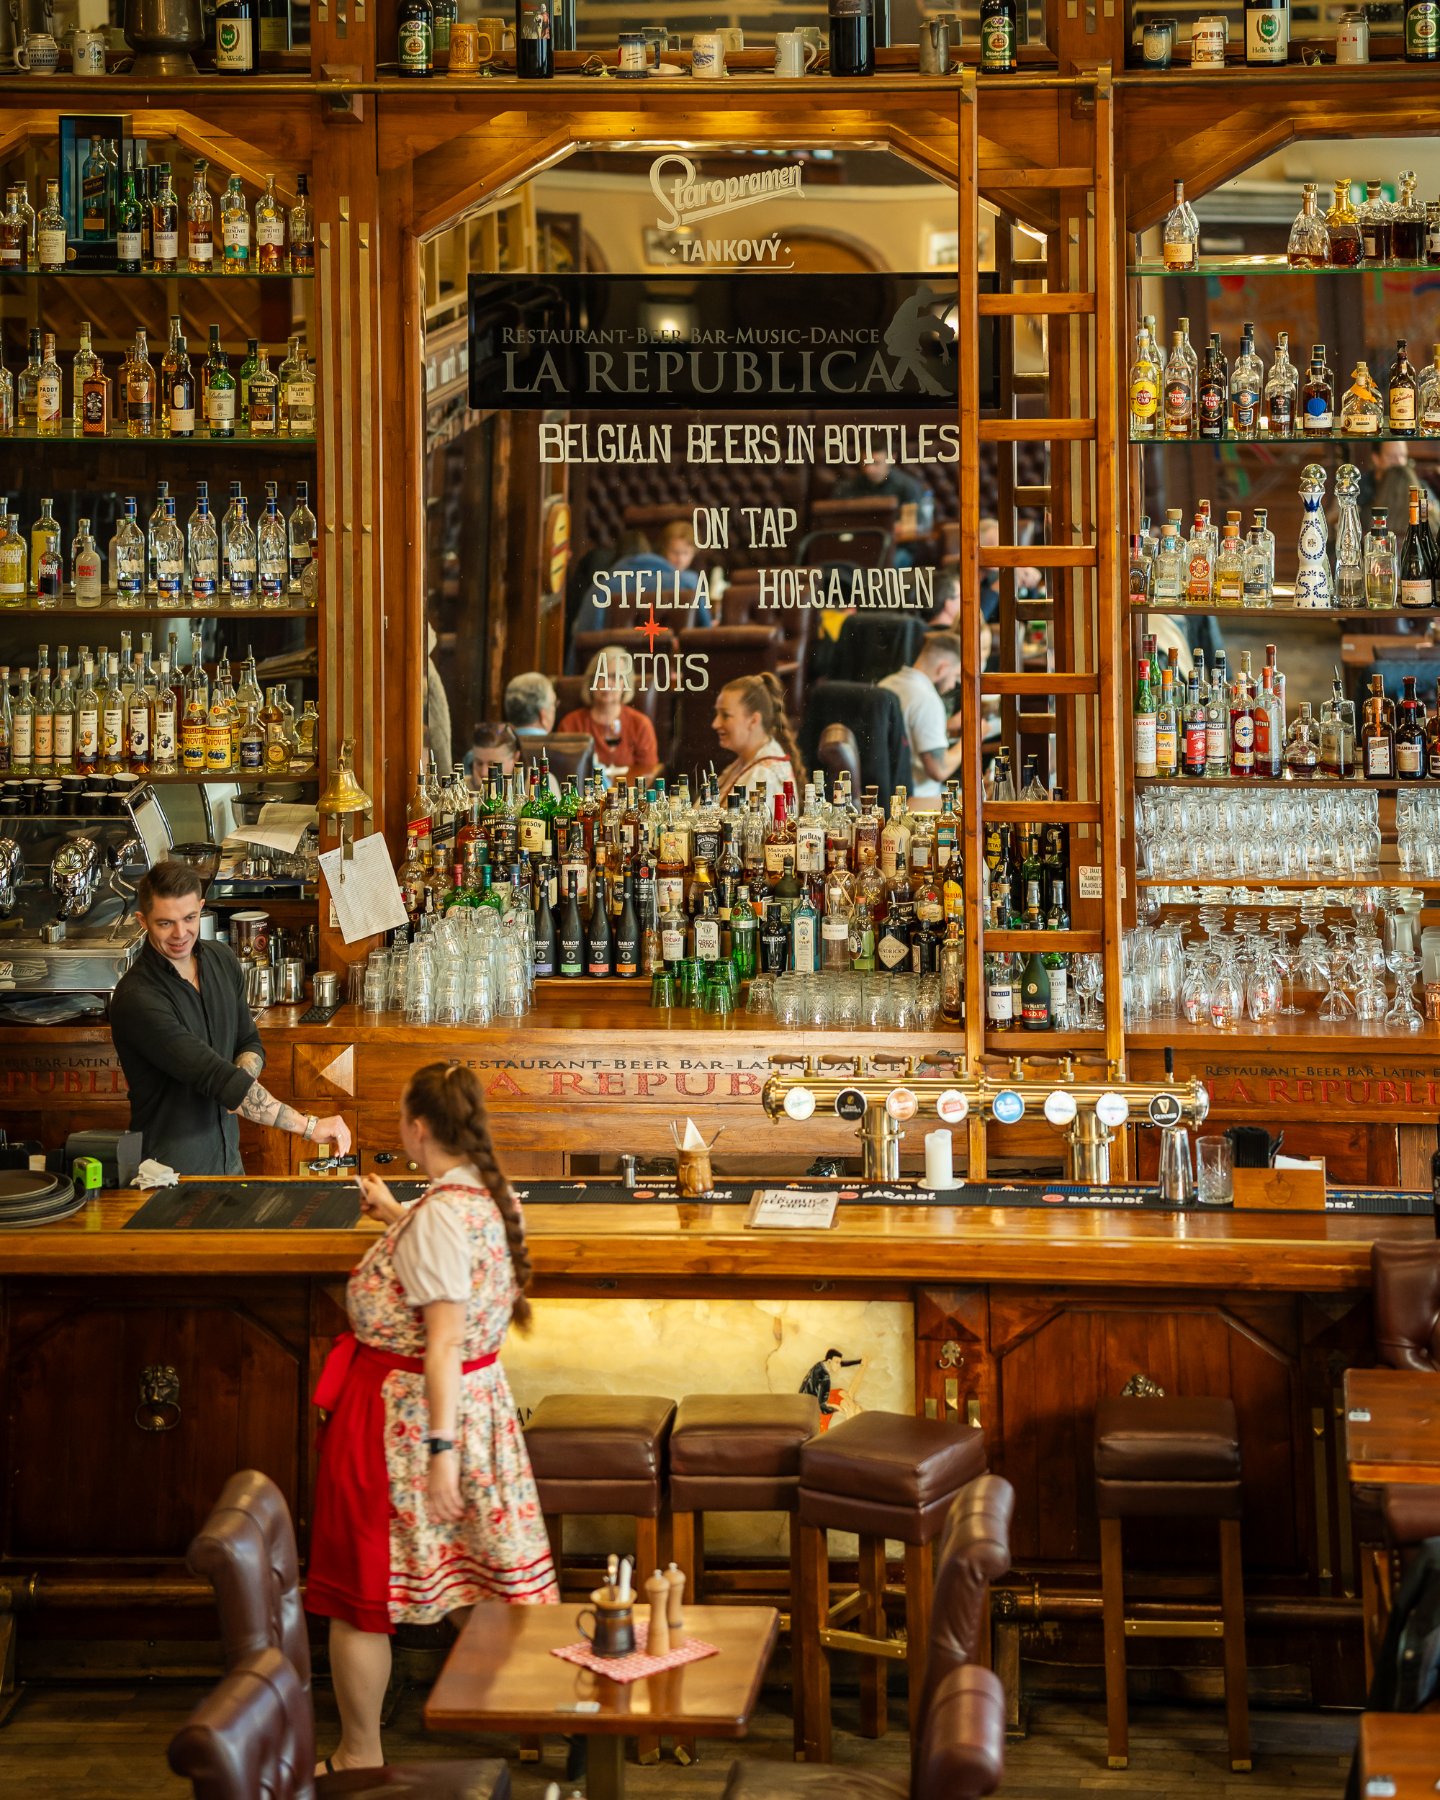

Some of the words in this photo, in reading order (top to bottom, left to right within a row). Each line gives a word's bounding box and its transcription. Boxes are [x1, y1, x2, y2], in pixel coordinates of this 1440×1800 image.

[649, 154, 805, 231] Staropramen
[679, 232, 781, 262] TANKOVÝ
[501, 350, 570, 393] LA
[585, 349, 903, 394] REPUBLICA
[539, 423, 672, 464] BELGIAN
[686, 424, 779, 464] BEERS
[785, 424, 816, 464] IN
[825, 424, 960, 465] BOTTLES
[692, 507, 728, 549] ON
[741, 507, 798, 549] TAP
[592, 569, 712, 610] STELLA
[757, 566, 936, 609] HOEGAARDEN
[590, 652, 710, 692] ARTOIS
[807, 832, 822, 840] BEAM
[7, 1070, 129, 1094] PUBLI
[1207, 1079, 1252, 1104] LA
